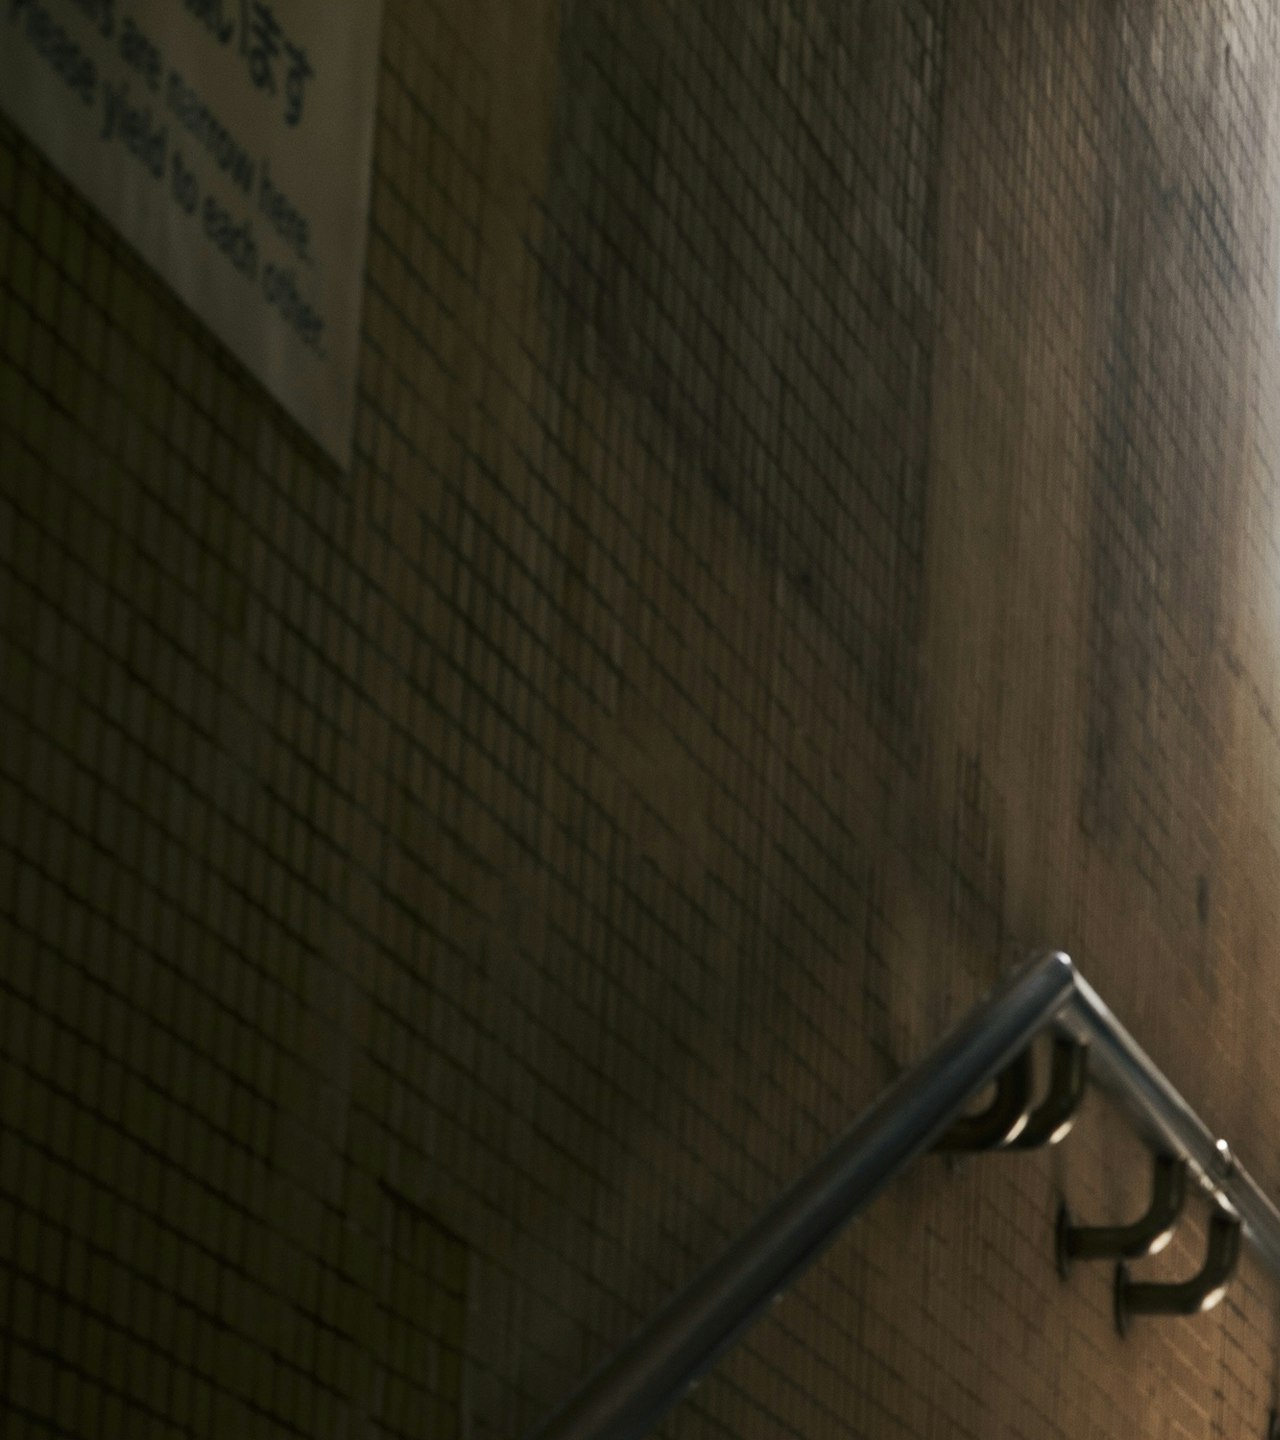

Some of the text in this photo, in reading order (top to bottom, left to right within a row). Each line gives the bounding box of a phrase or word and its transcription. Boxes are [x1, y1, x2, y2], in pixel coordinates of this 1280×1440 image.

[101, 78, 168, 179] yield
[171, 150, 199, 215] to
[201, 194, 259, 282] each
[119, 16, 162, 92] are
[166, 70, 255, 196] narrow
